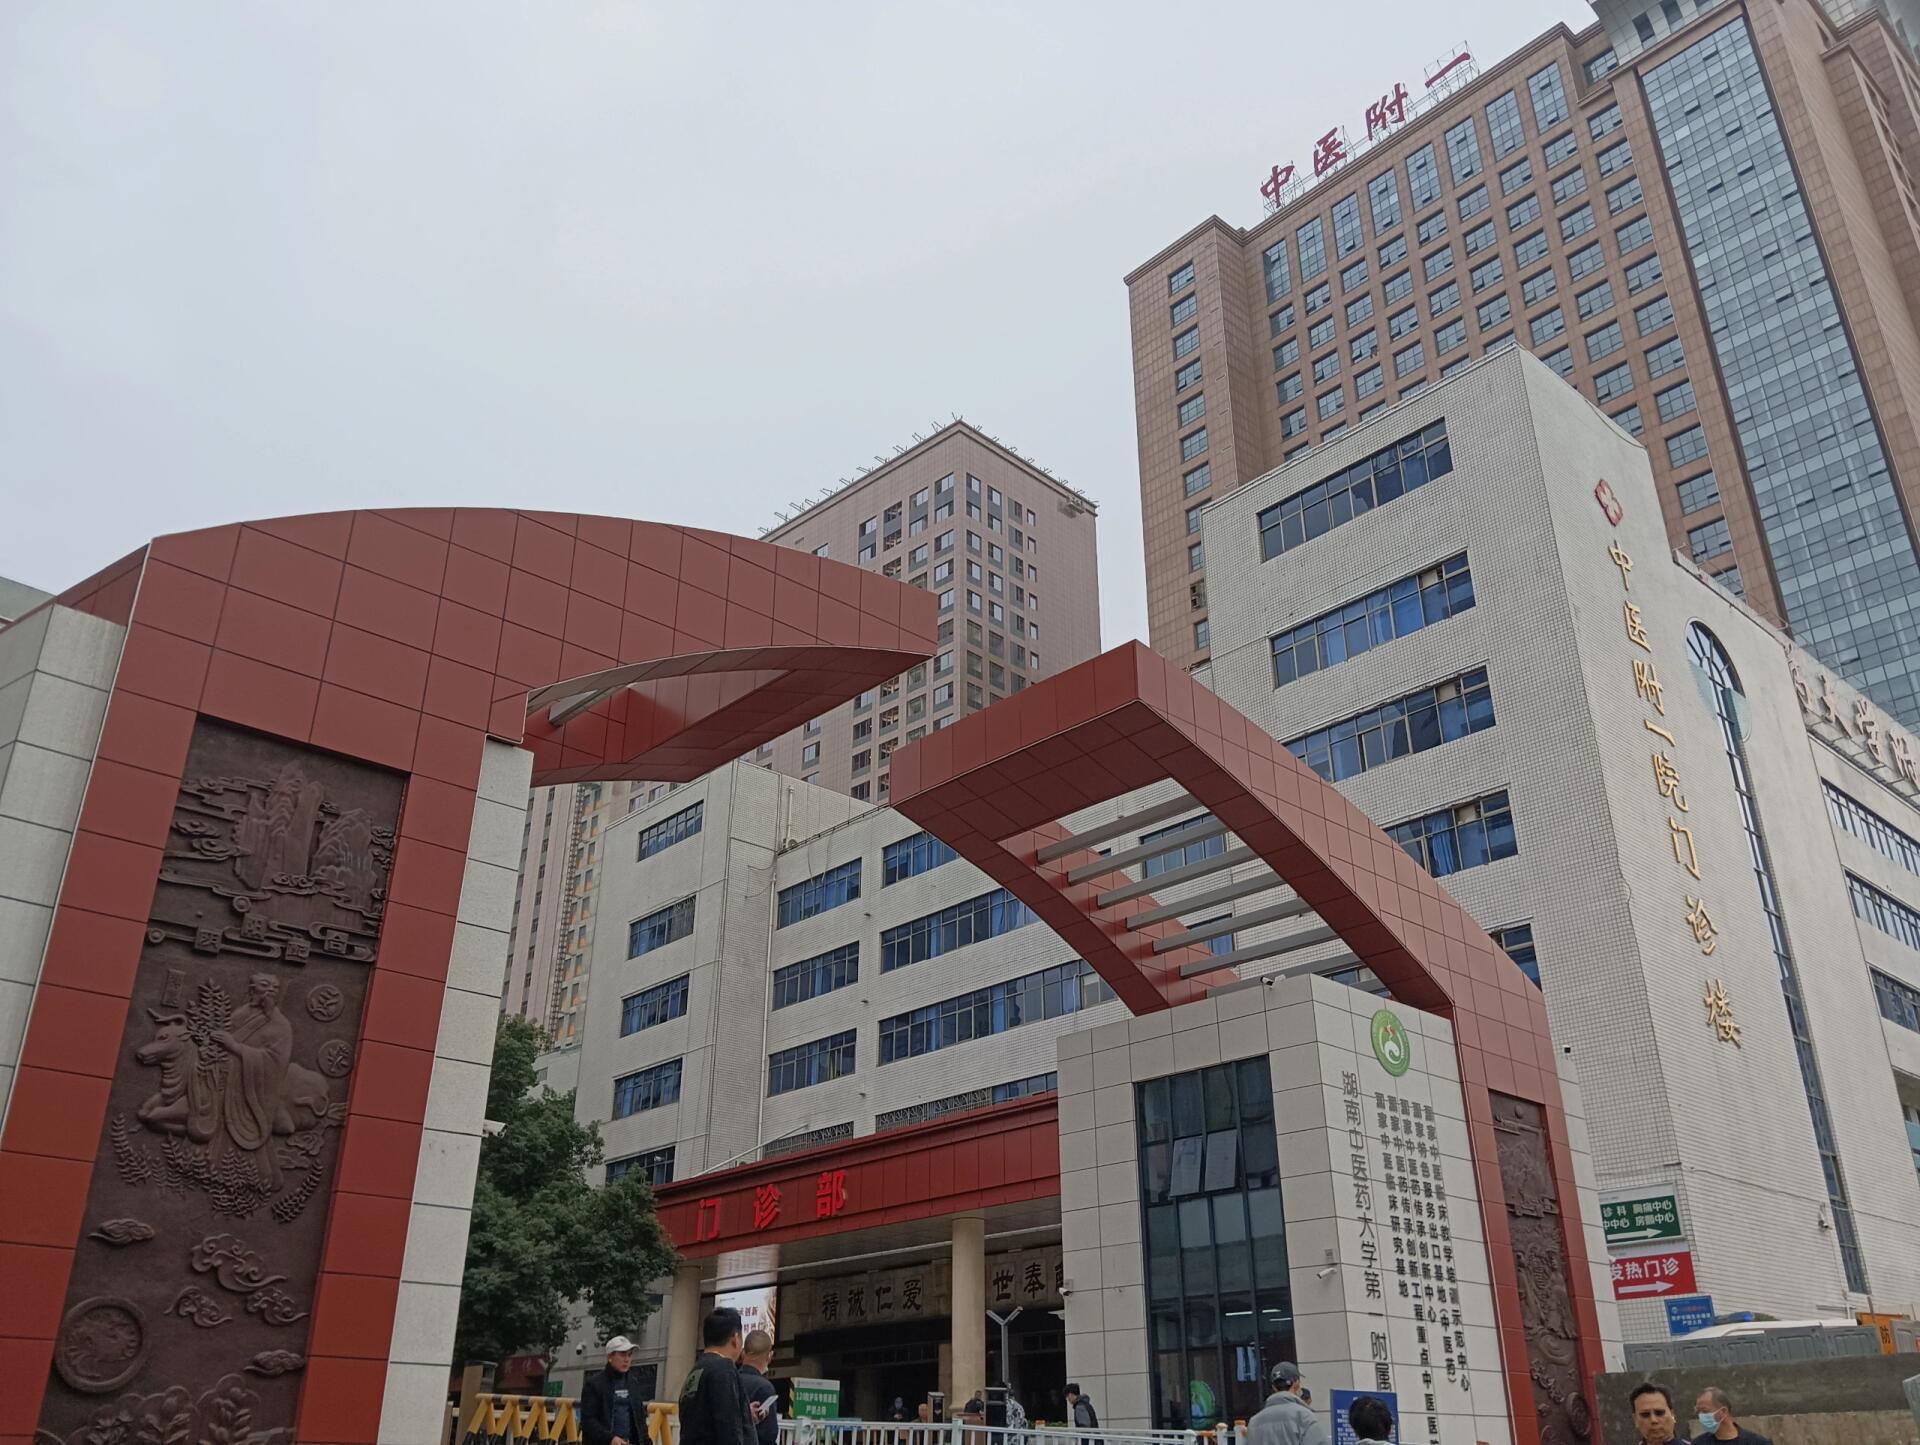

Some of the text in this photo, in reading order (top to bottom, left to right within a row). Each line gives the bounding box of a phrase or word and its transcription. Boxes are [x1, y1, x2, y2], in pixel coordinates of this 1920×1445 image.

[1260, 52, 1470, 208] 中医附一
[1608, 540, 1741, 1048] 中医附一院门诊楼
[696, 1169, 847, 1240] 门诊部
[1342, 1071, 1391, 1391] 湖南中医药大学第一附属
[1375, 1092, 1408, 1297] 国家中医临床研究基地
[1387, 1095, 1439, 1445] 国家中医药传承创新工程重点中医医
[1400, 1098, 1437, 1323] 国家中医药传承创新中心
[1611, 1257, 1680, 1281] 发热门诊
[822, 1278, 922, 1321] 精诚仁爱
